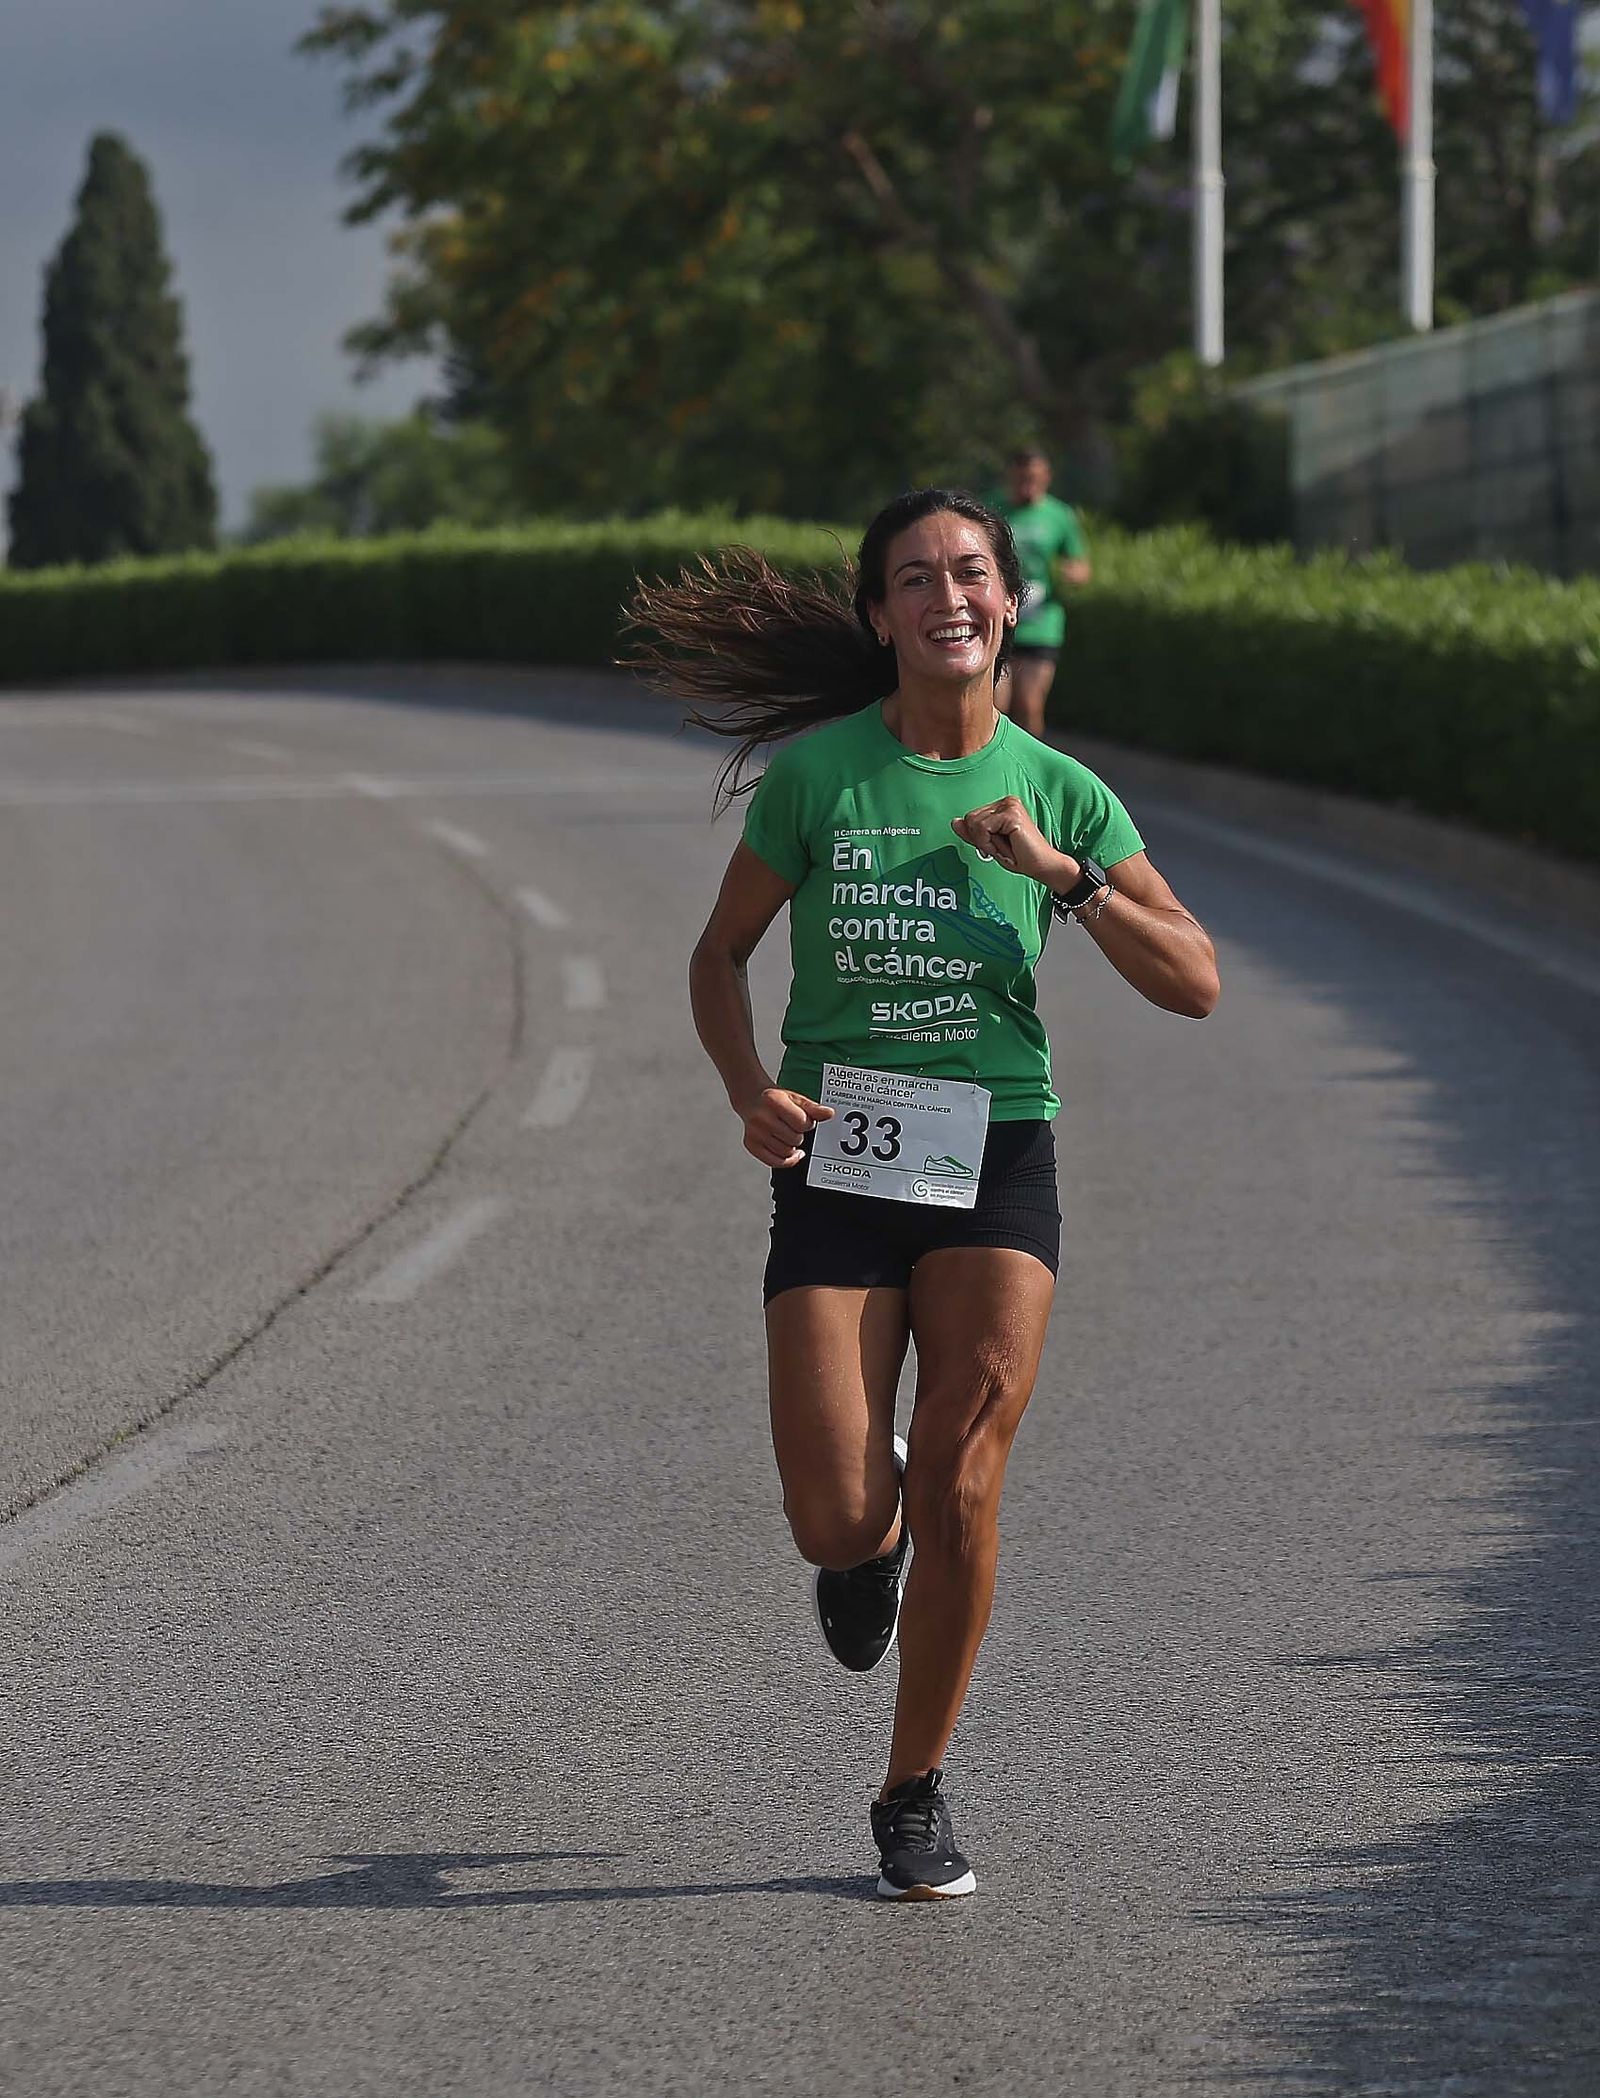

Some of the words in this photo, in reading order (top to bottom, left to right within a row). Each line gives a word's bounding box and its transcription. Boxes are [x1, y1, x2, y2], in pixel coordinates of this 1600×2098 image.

[882, 827, 921, 837] Algeciras
[832, 841, 872, 871] En
[832, 878, 957, 910] marcha
[828, 913, 936, 942] contra
[834, 946, 860, 972] el
[864, 946, 983, 981] cáncer
[827, 1077, 862, 1091] contra
[864, 1083, 875, 1093] el
[876, 1086, 916, 1099] cáncer
[828, 1066, 879, 1083] Algeciras
[881, 1077, 895, 1086] en
[897, 1079, 940, 1092] marcha
[867, 1096, 892, 1106] MARCHA
[892, 1101, 918, 1110] CONTRA
[927, 1105, 952, 1114] CÁNCER
[839, 1110, 902, 1162] 33
